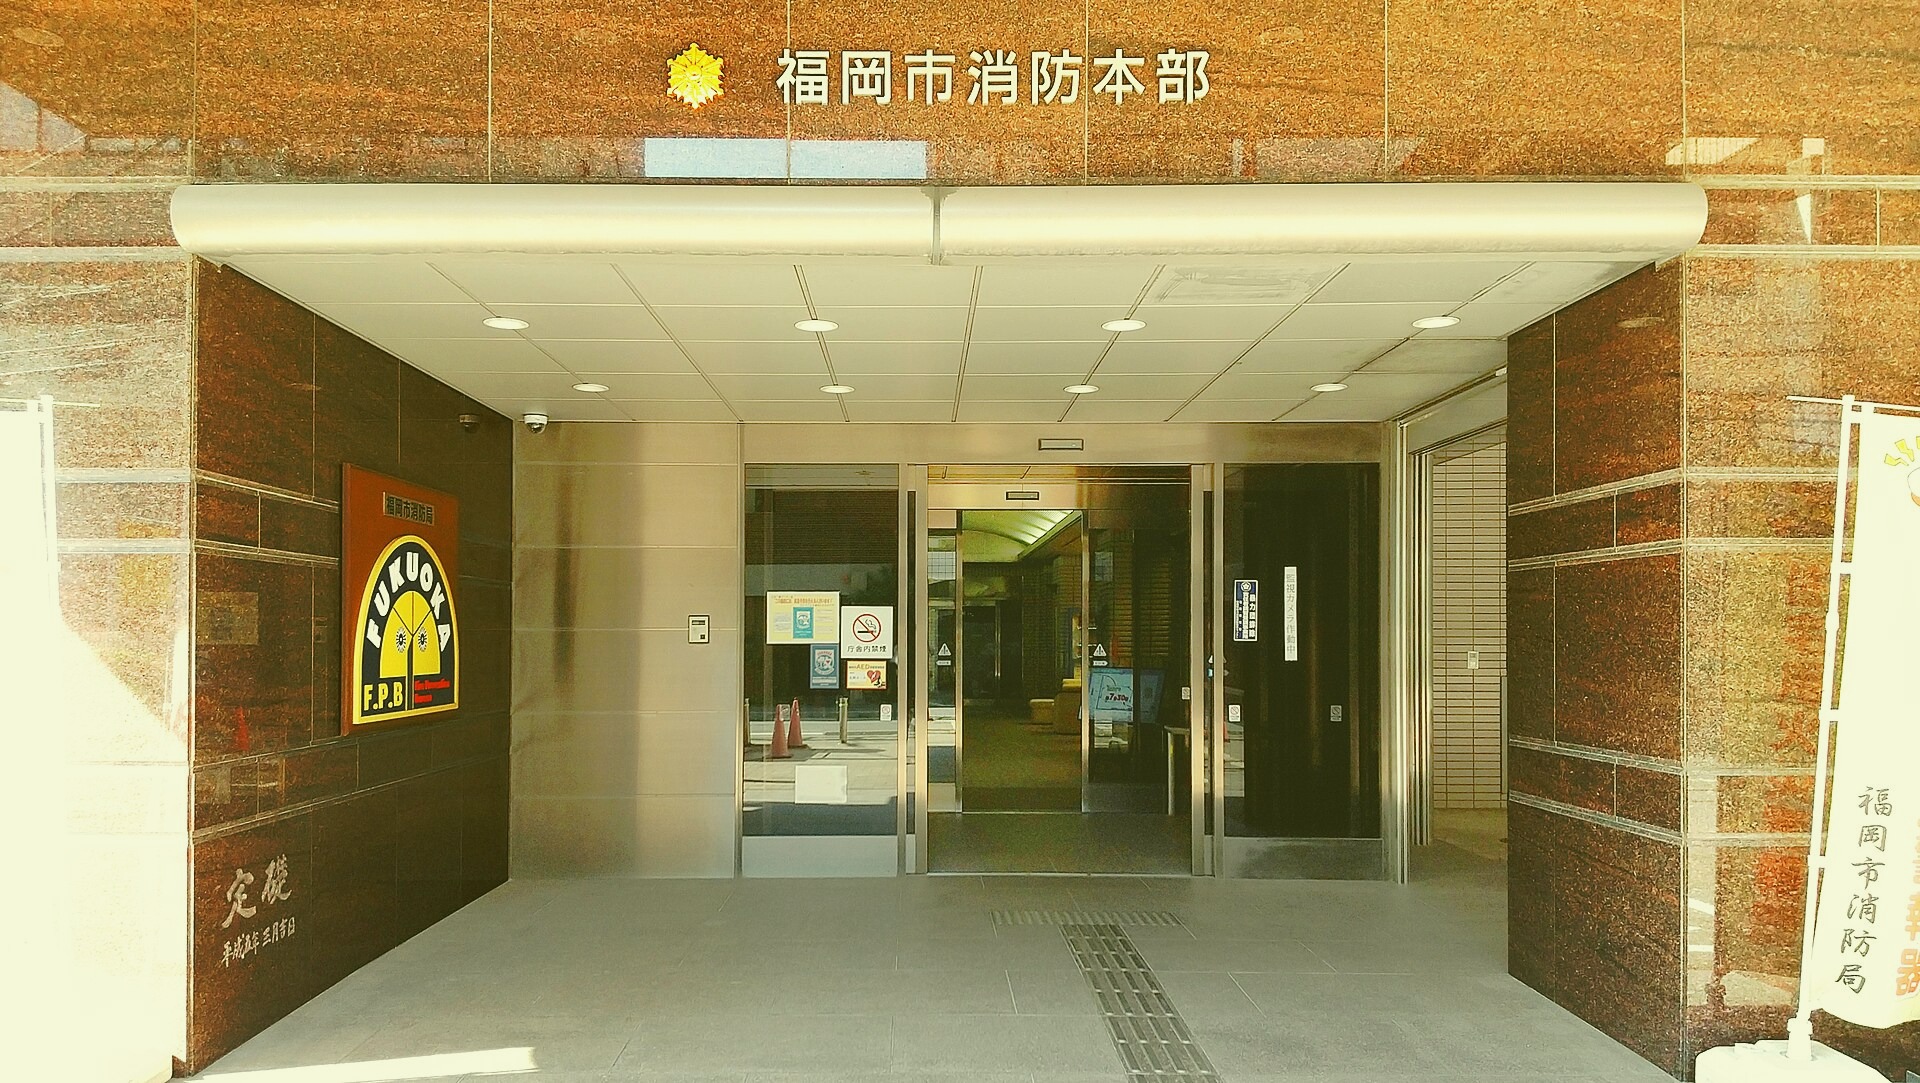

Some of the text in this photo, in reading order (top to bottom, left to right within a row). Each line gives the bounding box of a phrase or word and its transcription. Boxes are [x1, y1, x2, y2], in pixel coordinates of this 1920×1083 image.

[774, 47, 1212, 107] 福岡市消防本部
[386, 496, 433, 524] 福岡市消防局
[365, 551, 451, 652] FUKUOKA
[1286, 574, 1296, 654] 監視カメラ作動中
[847, 645, 887, 653] 庁舎内禁煙
[363, 681, 404, 711] F.P.B
[221, 853, 293, 929] 定礎
[1835, 784, 1893, 995] 福岡市消防局
